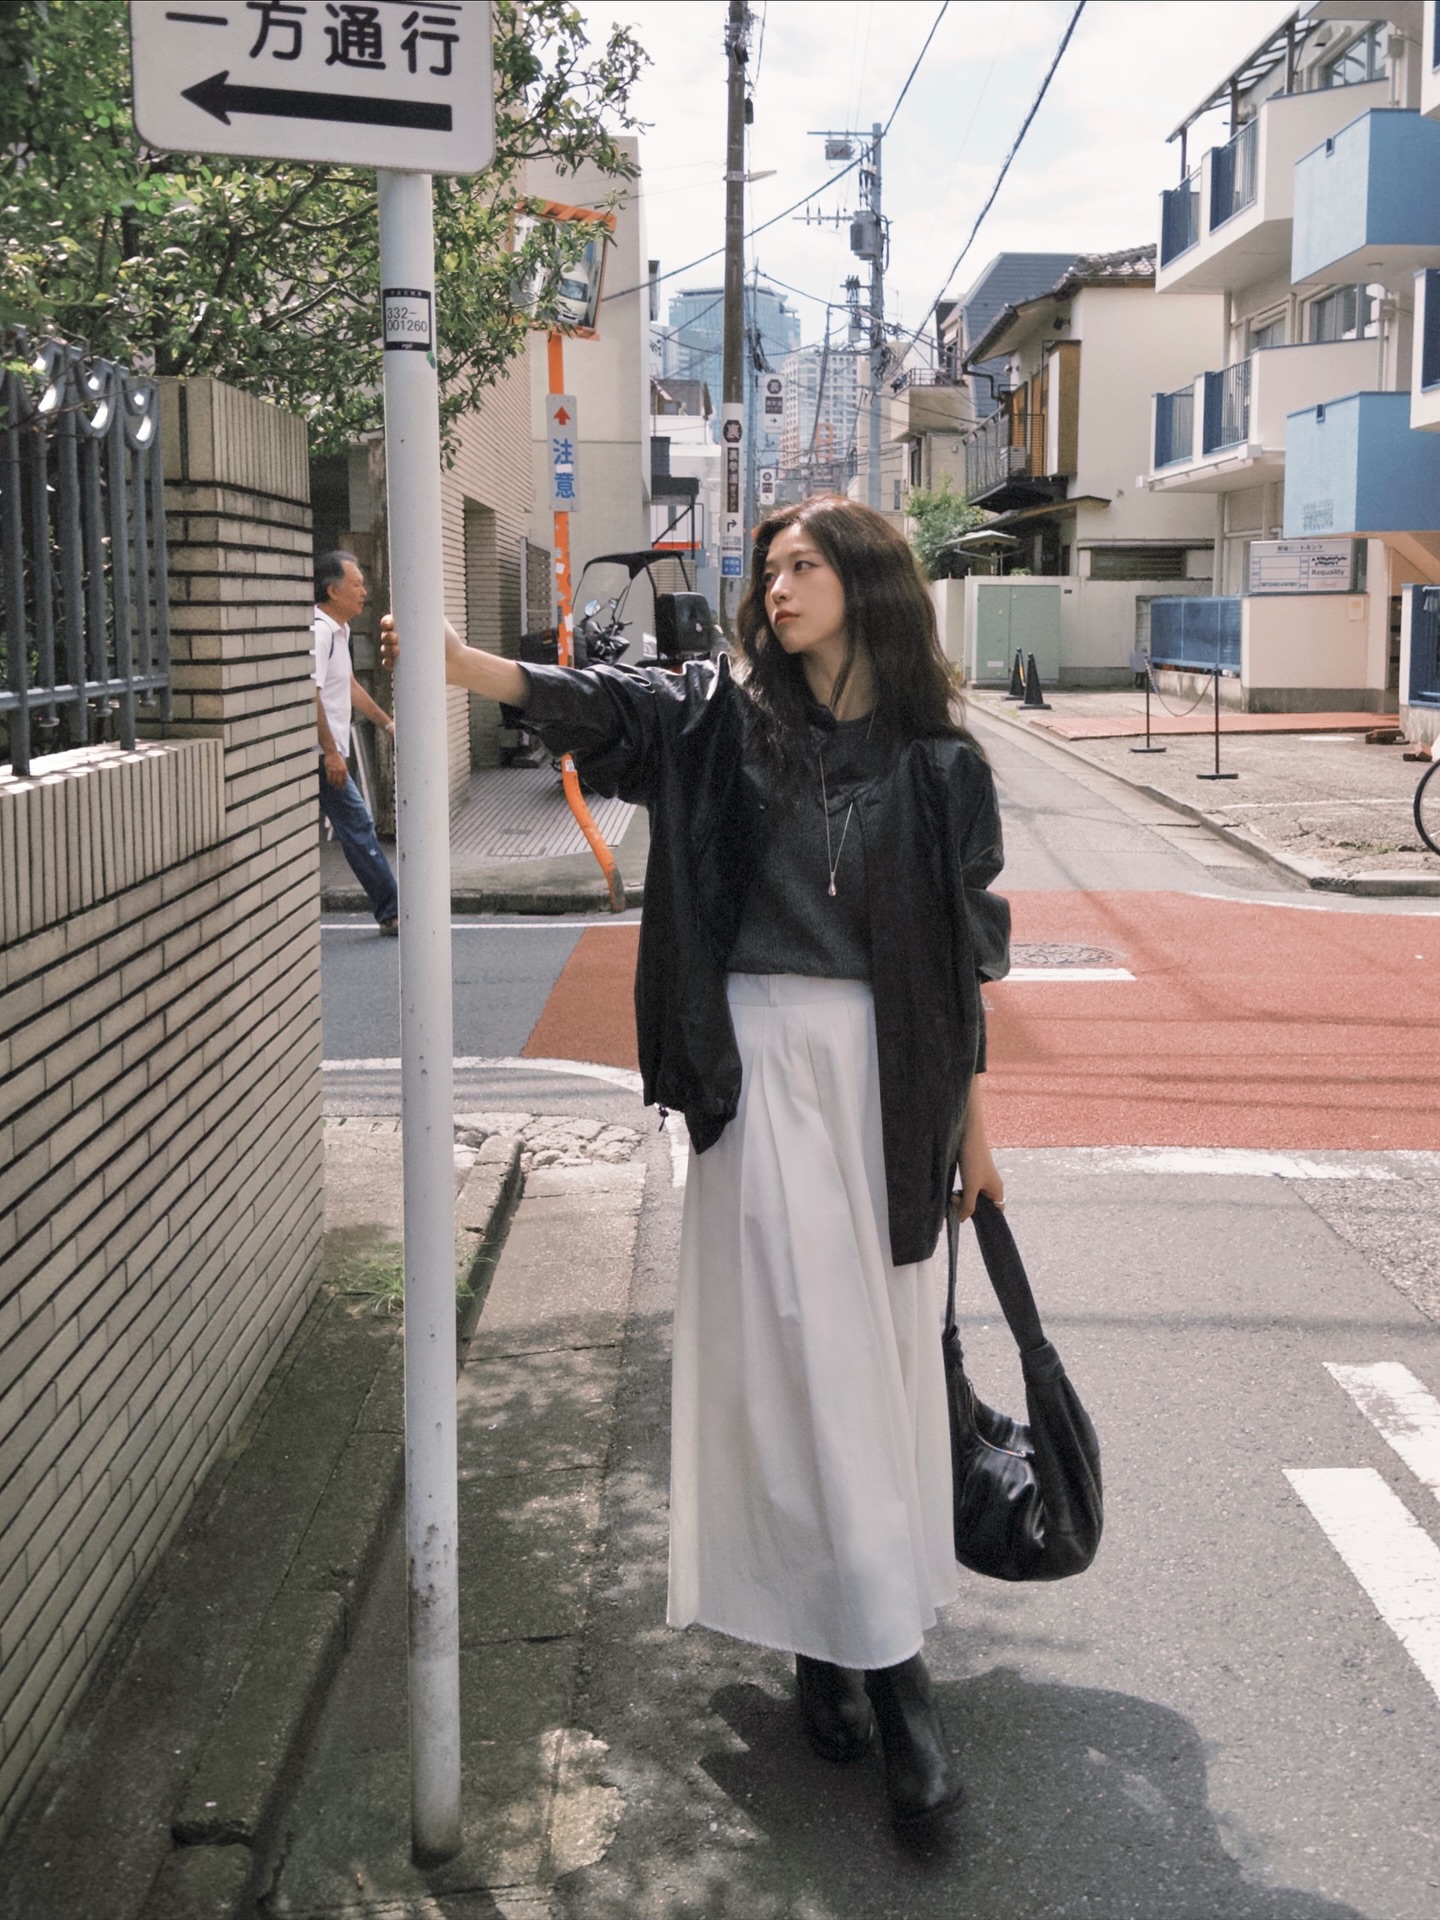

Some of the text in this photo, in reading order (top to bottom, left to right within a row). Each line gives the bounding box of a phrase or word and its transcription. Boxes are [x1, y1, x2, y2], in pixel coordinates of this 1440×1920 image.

[165, 1, 459, 76] 一方通行
[387, 307, 417, 319] 332-
[387, 319, 428, 332] 001260
[553, 438, 575, 498] 注意
[1311, 569, 1345, 577] Requality
